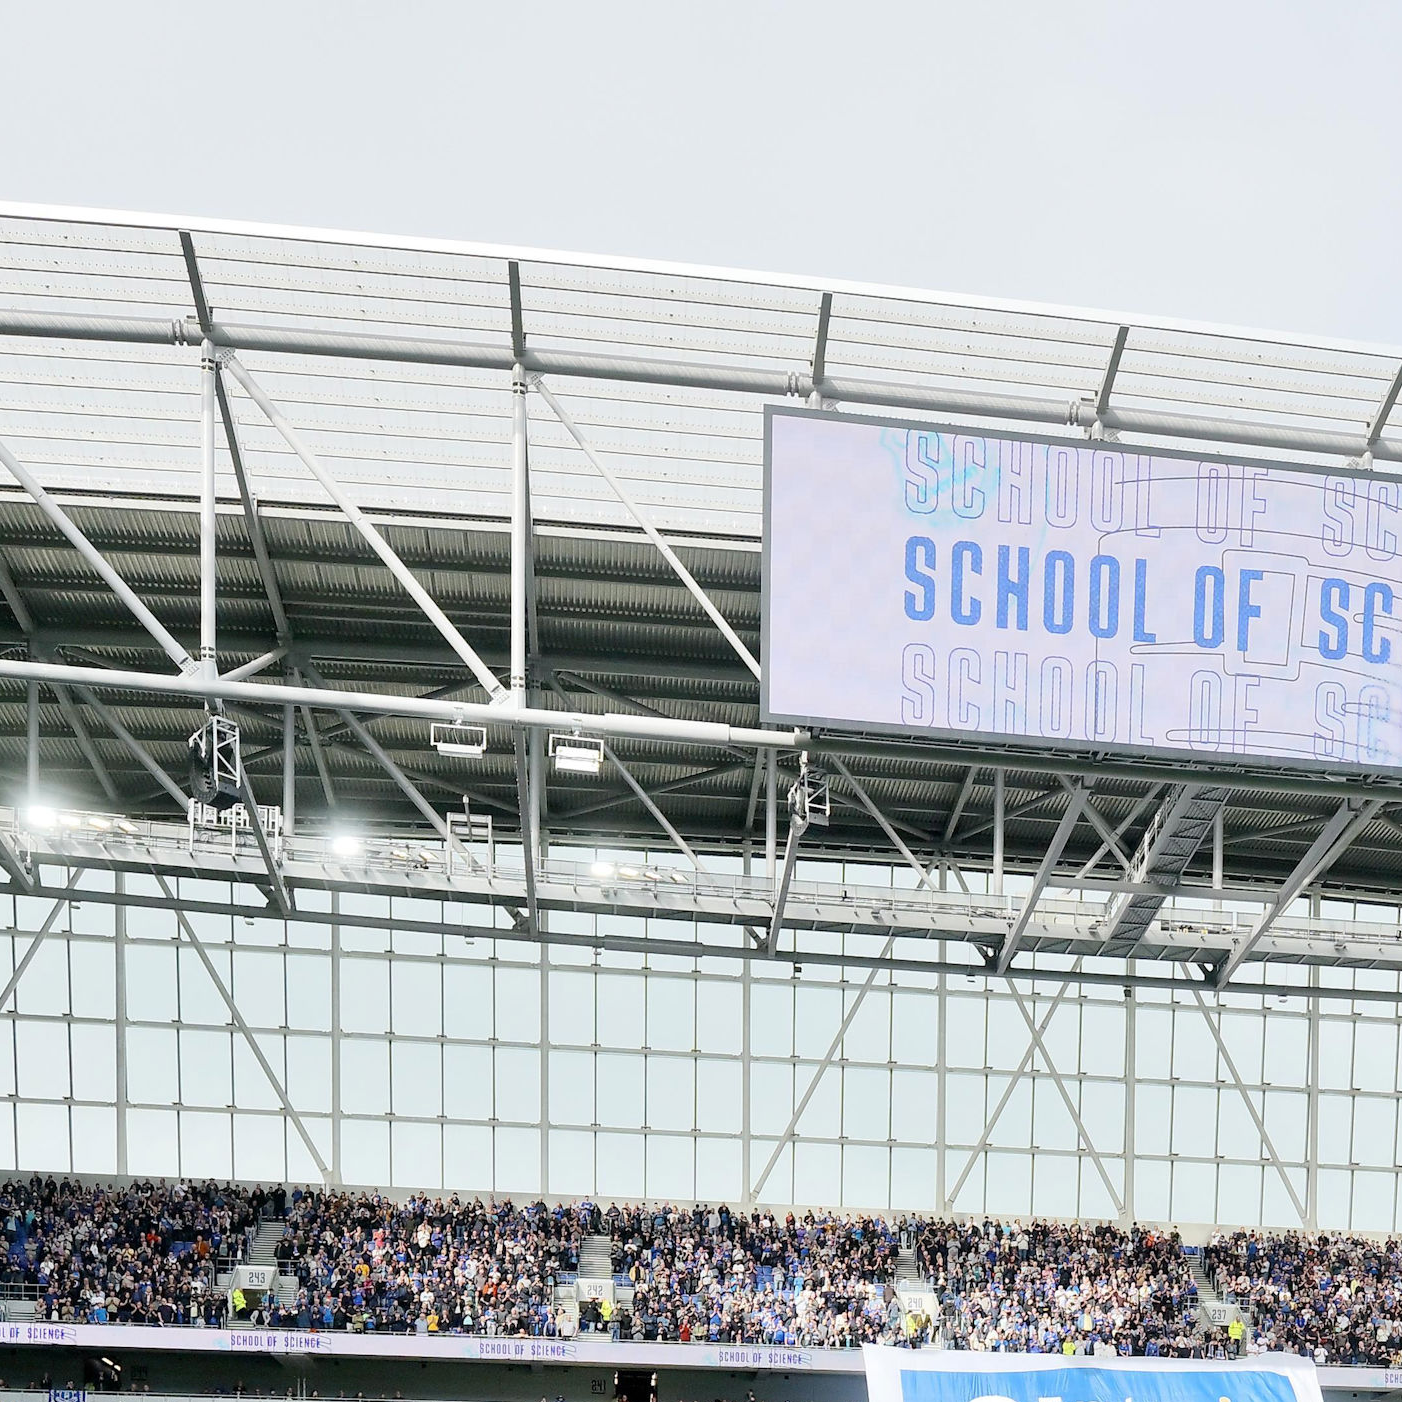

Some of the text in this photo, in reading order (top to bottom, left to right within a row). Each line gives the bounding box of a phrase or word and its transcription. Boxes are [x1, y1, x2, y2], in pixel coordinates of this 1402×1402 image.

[904, 428, 1161, 540] SCHOOL
[902, 536, 1158, 645] SCHOOL
[1193, 564, 1266, 653] OF
[248, 1271, 266, 1284] 243
[587, 1284, 603, 1296] 242
[907, 1297, 923, 1308] 240
[1211, 1309, 1227, 1320] 237
[9, 1327, 20, 1339] OF
[27, 1327, 65, 1340] SCIENCE
[231, 1335, 321, 1349] SCHOOL OF SCIENCE
[479, 1342, 566, 1357] SCHOOL OF SCIENCE
[719, 1351, 802, 1365] SCHOOL OF SCIENCE
